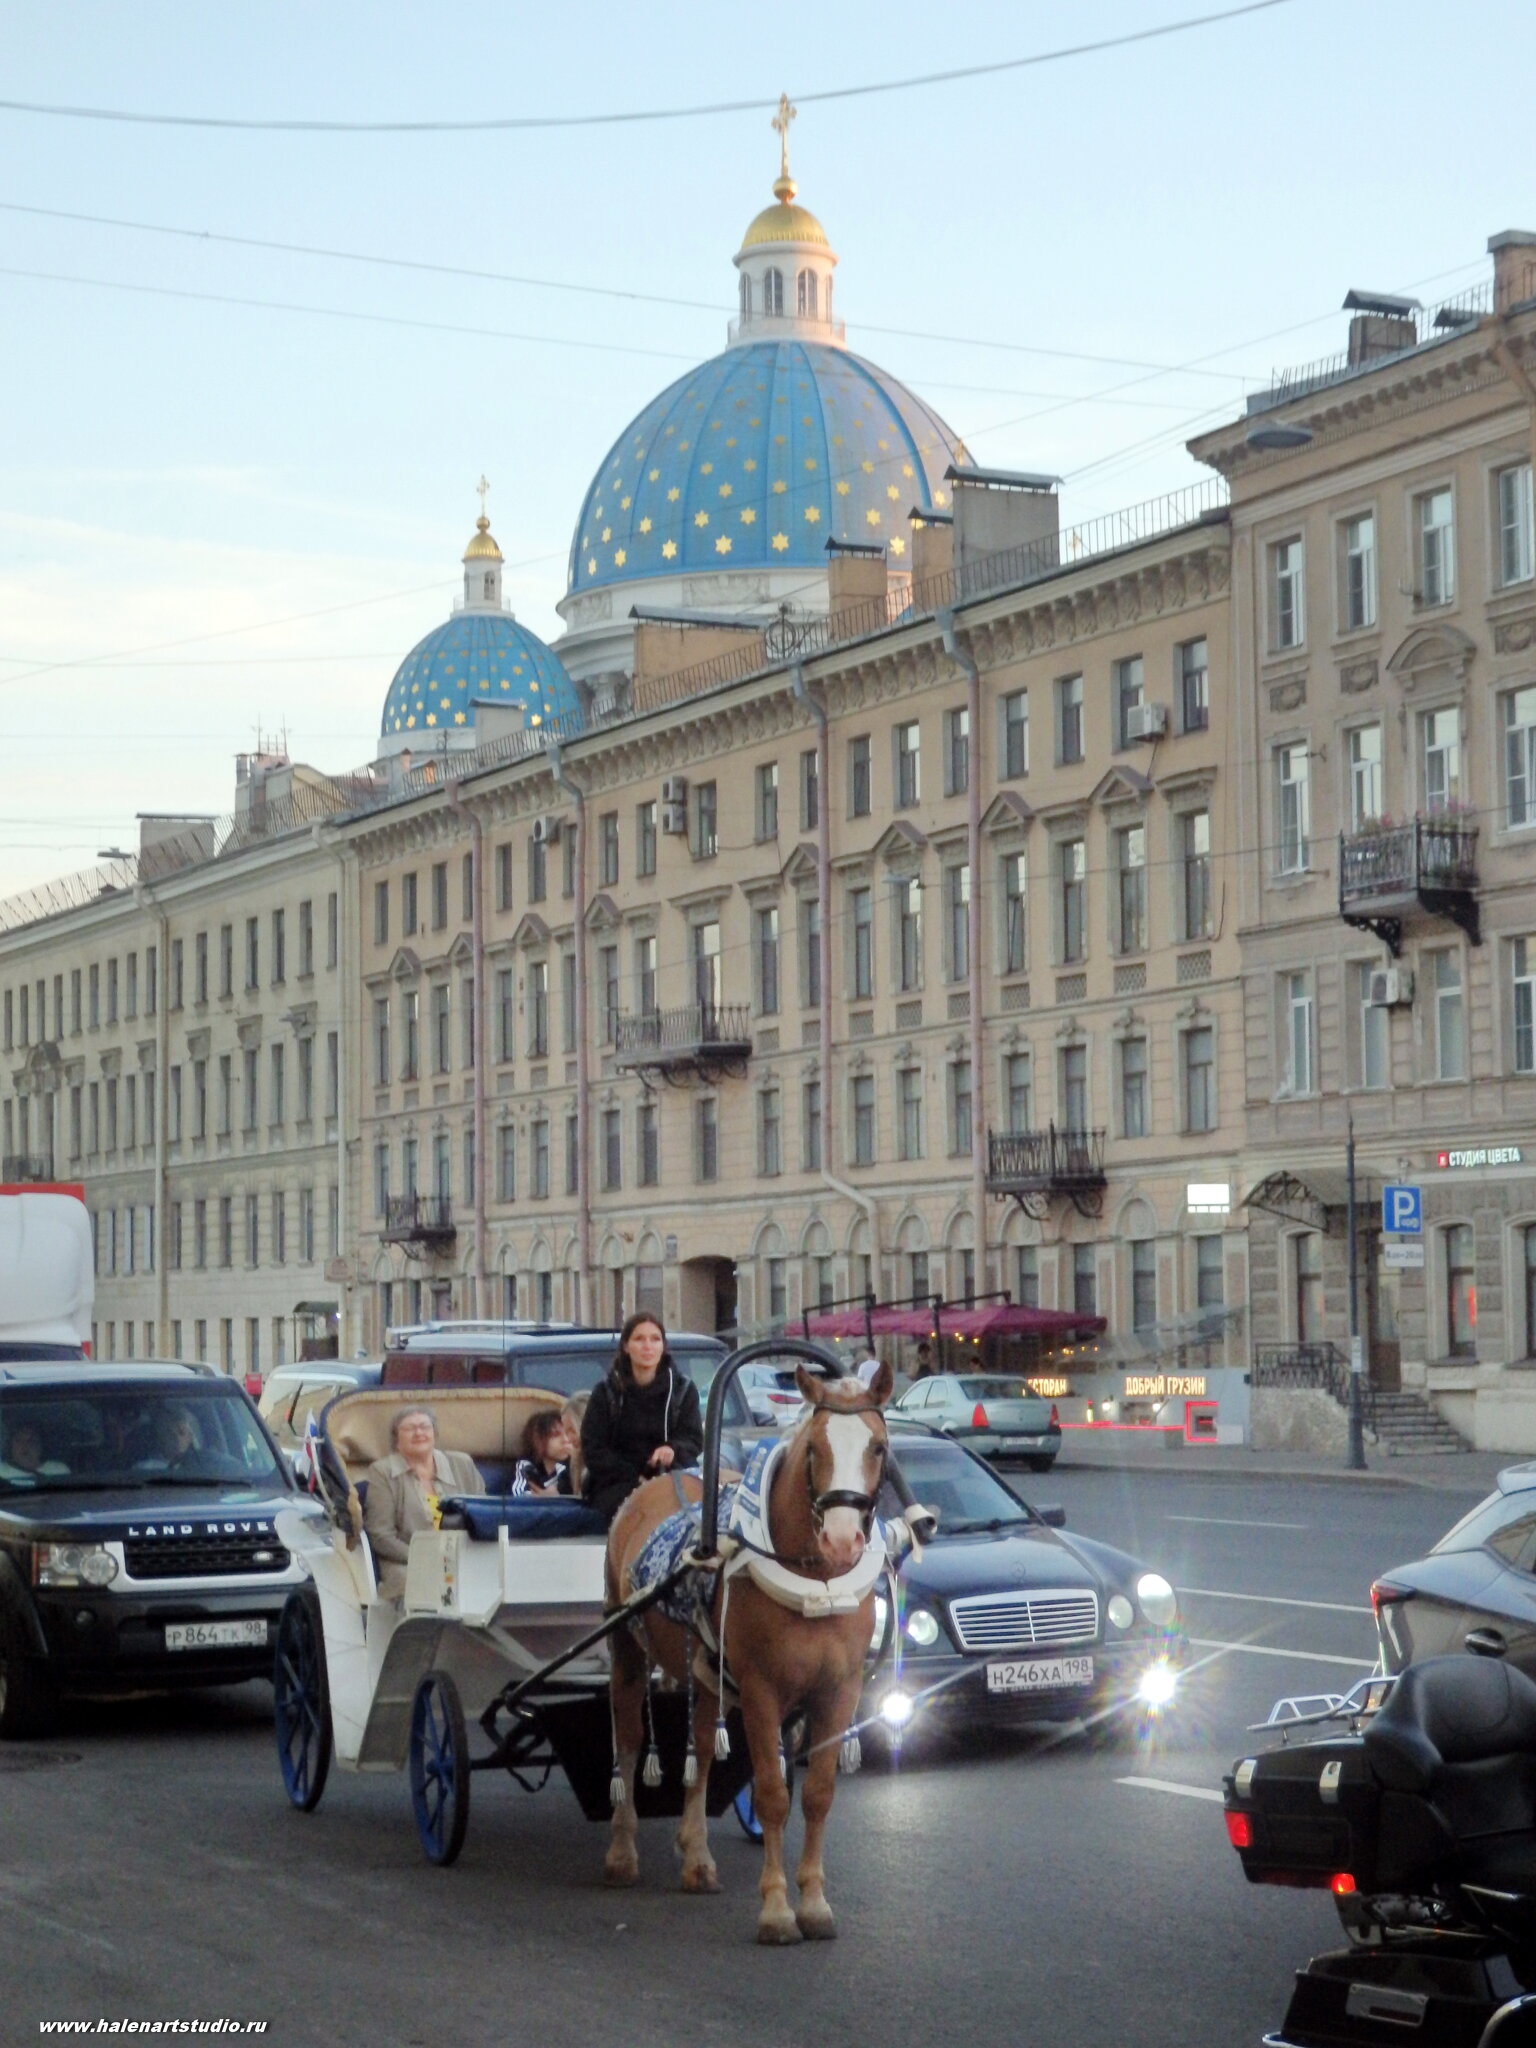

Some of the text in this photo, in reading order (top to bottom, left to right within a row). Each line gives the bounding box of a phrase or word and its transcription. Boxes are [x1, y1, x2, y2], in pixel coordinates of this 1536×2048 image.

[1449, 1147, 1521, 1167] СТУДИЯ ЦВЕТА
[1393, 1190, 1415, 1228] P
[1028, 1378, 1067, 1397] СТОРАН
[1125, 1375, 1206, 1396] ДОБРЫЙ ГРУЗИН
[128, 1521, 269, 1536] LAND ROVE
